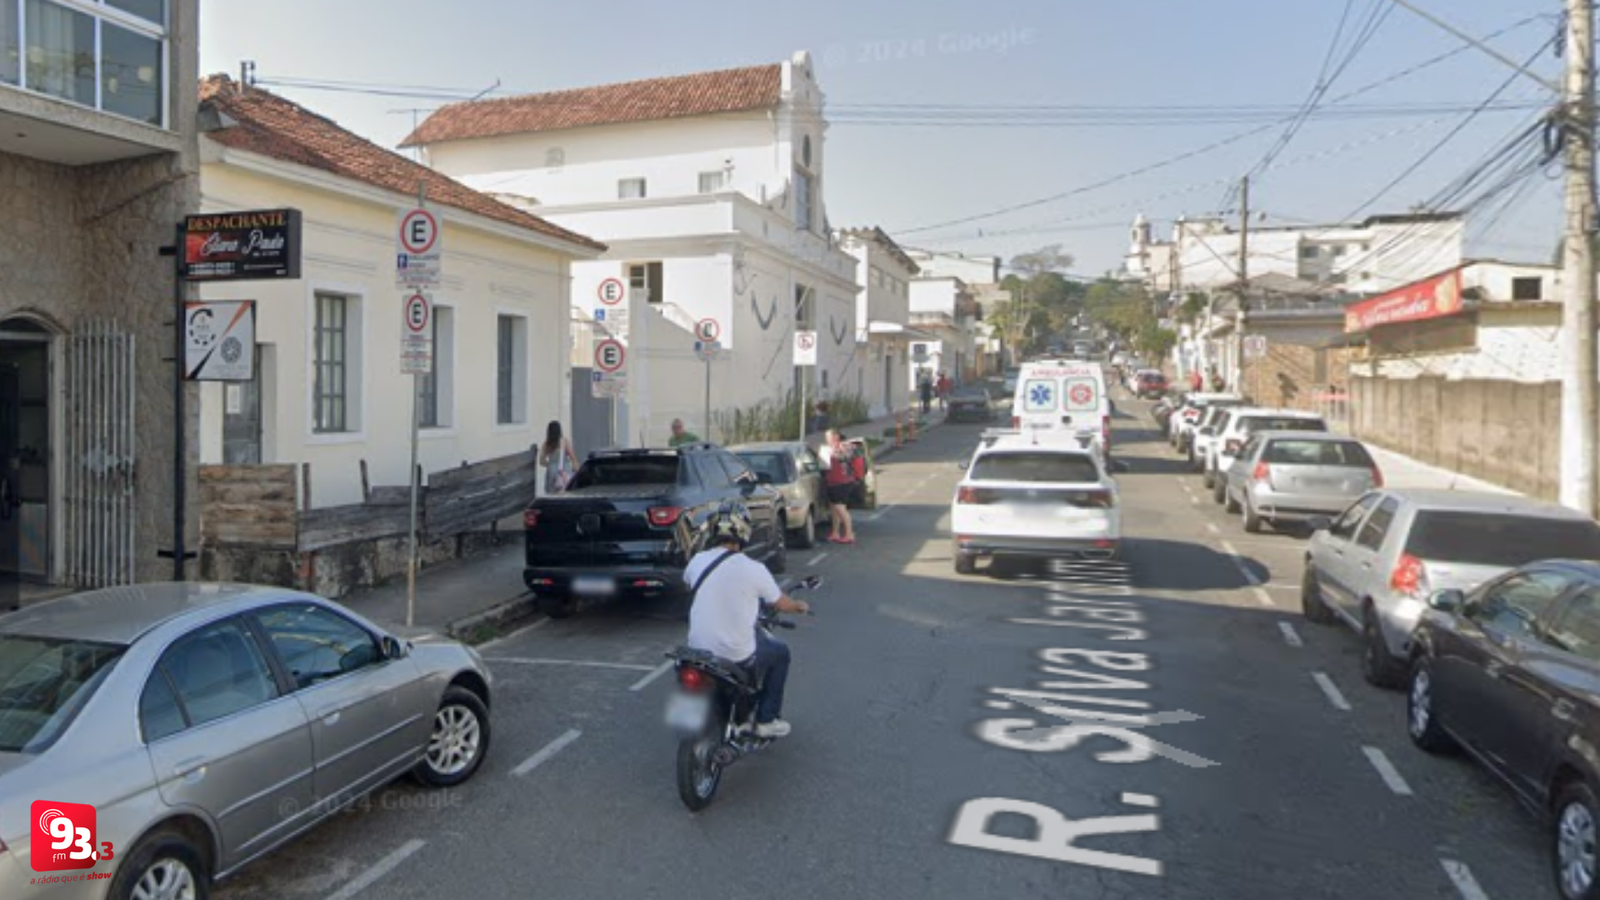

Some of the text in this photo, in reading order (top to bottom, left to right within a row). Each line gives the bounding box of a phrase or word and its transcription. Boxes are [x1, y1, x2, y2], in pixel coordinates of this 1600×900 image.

[188, 212, 286, 231] DESPACHANTE
[411, 220, 426, 243] E
[605, 284, 616, 300] E
[413, 303, 422, 324] E
[604, 346, 616, 364] E
